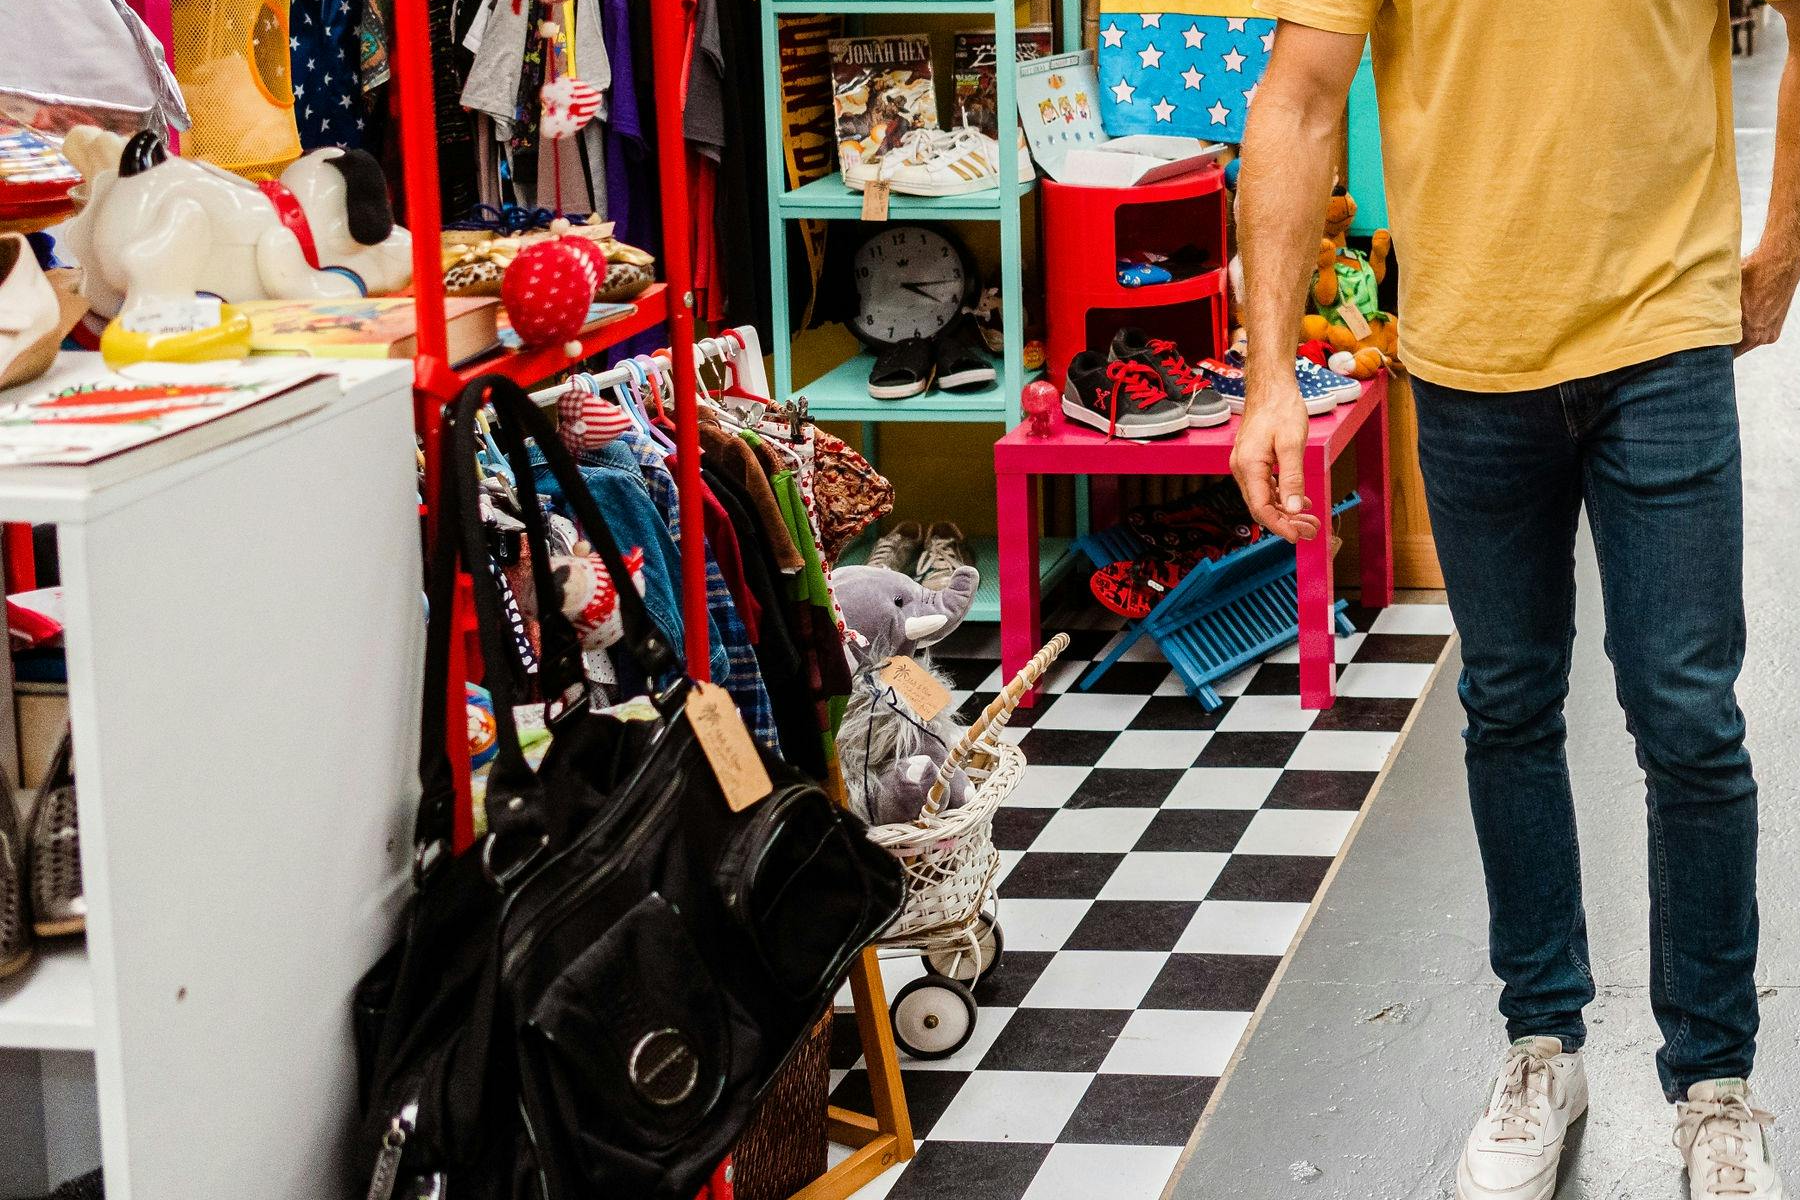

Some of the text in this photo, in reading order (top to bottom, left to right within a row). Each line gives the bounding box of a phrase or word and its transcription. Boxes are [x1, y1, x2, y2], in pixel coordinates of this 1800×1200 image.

[845, 40, 926, 65] JONAH HEX
[891, 232, 906, 246] 12
[920, 234, 927, 245] 1
[869, 245, 883, 258] 11
[941, 246, 949, 258] 2
[952, 267, 960, 279] 3
[866, 314, 874, 326] 8
[937, 314, 944, 327] 5
[887, 326, 895, 339] 7
